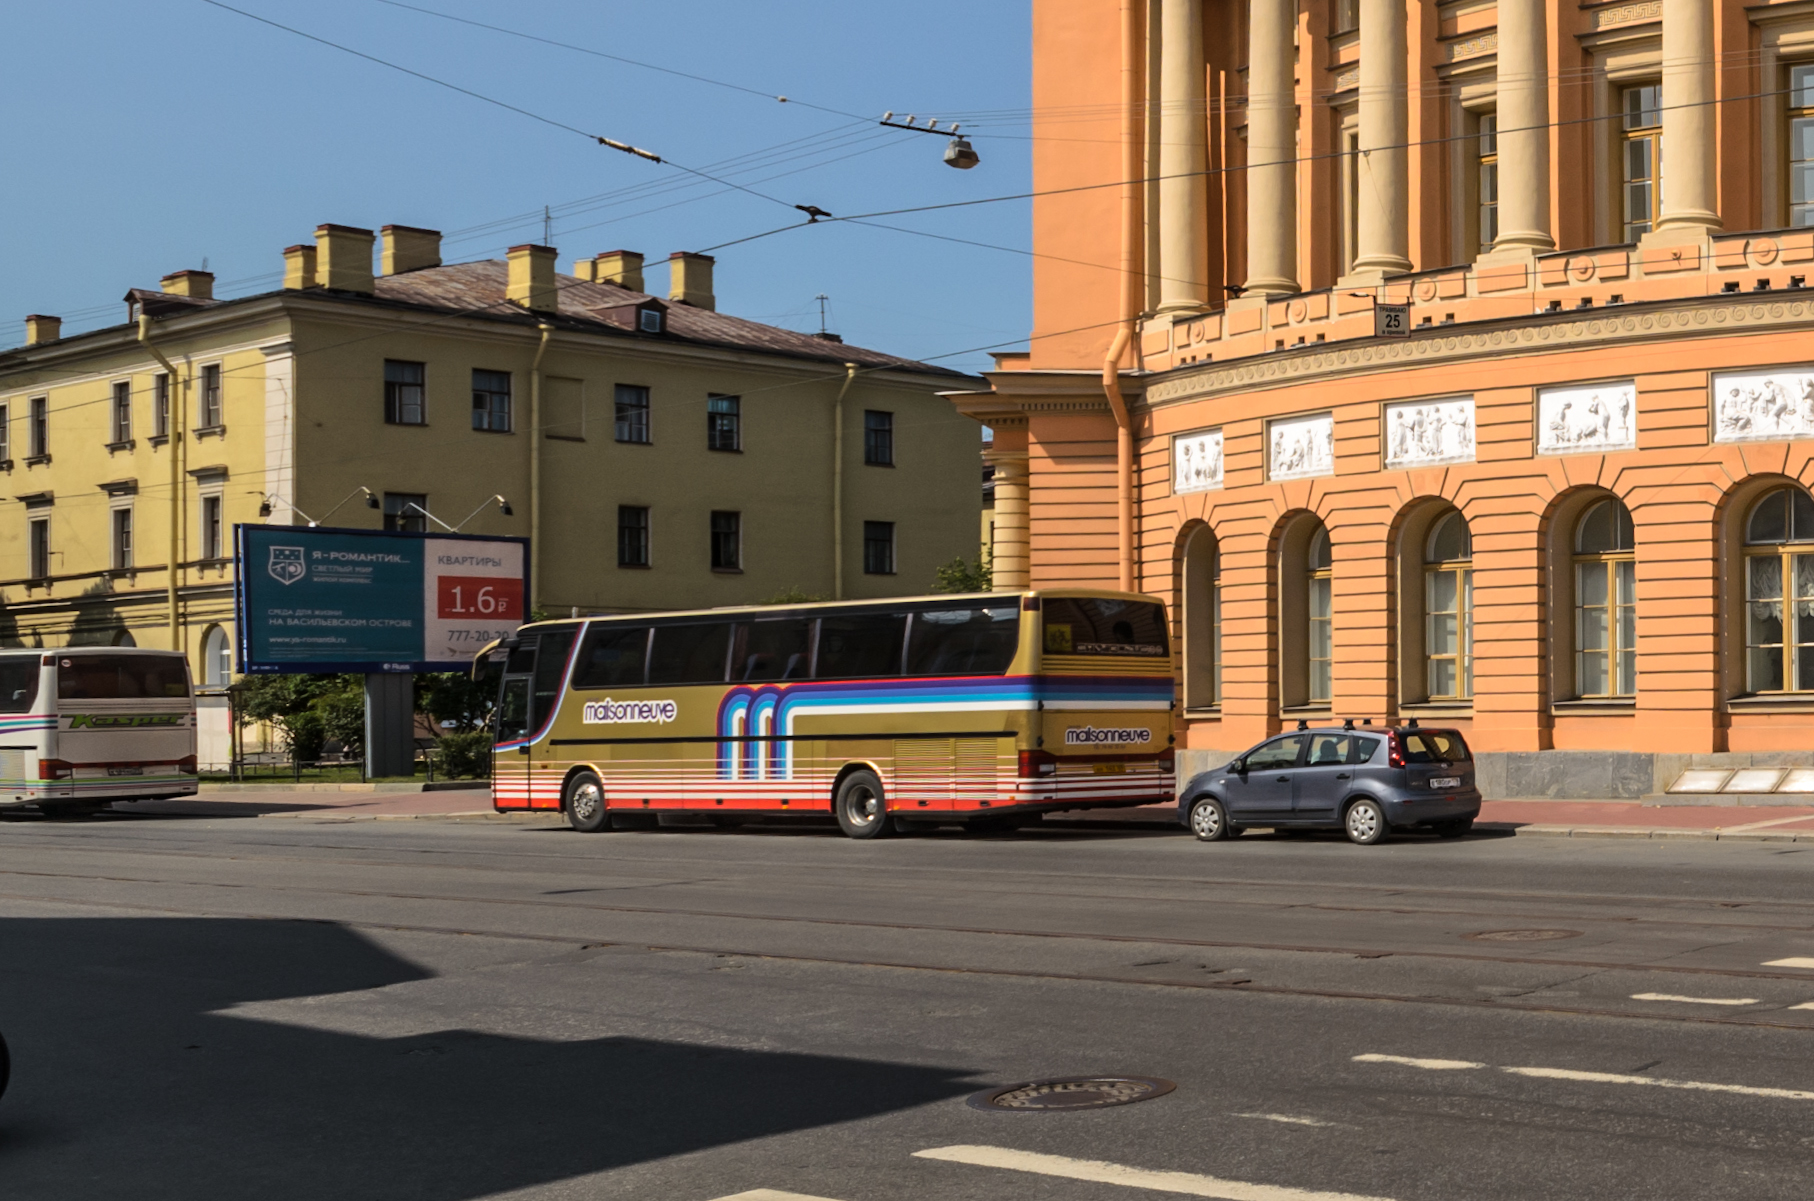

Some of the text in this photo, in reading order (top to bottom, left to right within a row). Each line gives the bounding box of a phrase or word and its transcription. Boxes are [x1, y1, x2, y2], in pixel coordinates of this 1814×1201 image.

[438, 556, 502, 567] КВАРТИРЫ
[295, 609, 312, 617] ДЛЯ
[269, 618, 413, 628] НА ВАСИЛЬЕВСКОМ ОСТРОВЕ
[448, 630, 510, 642] 777-20-20
[584, 699, 676, 723] maisonneuve
[60, 712, 189, 729] Kasper
[1066, 726, 1151, 743] maisonneuve
